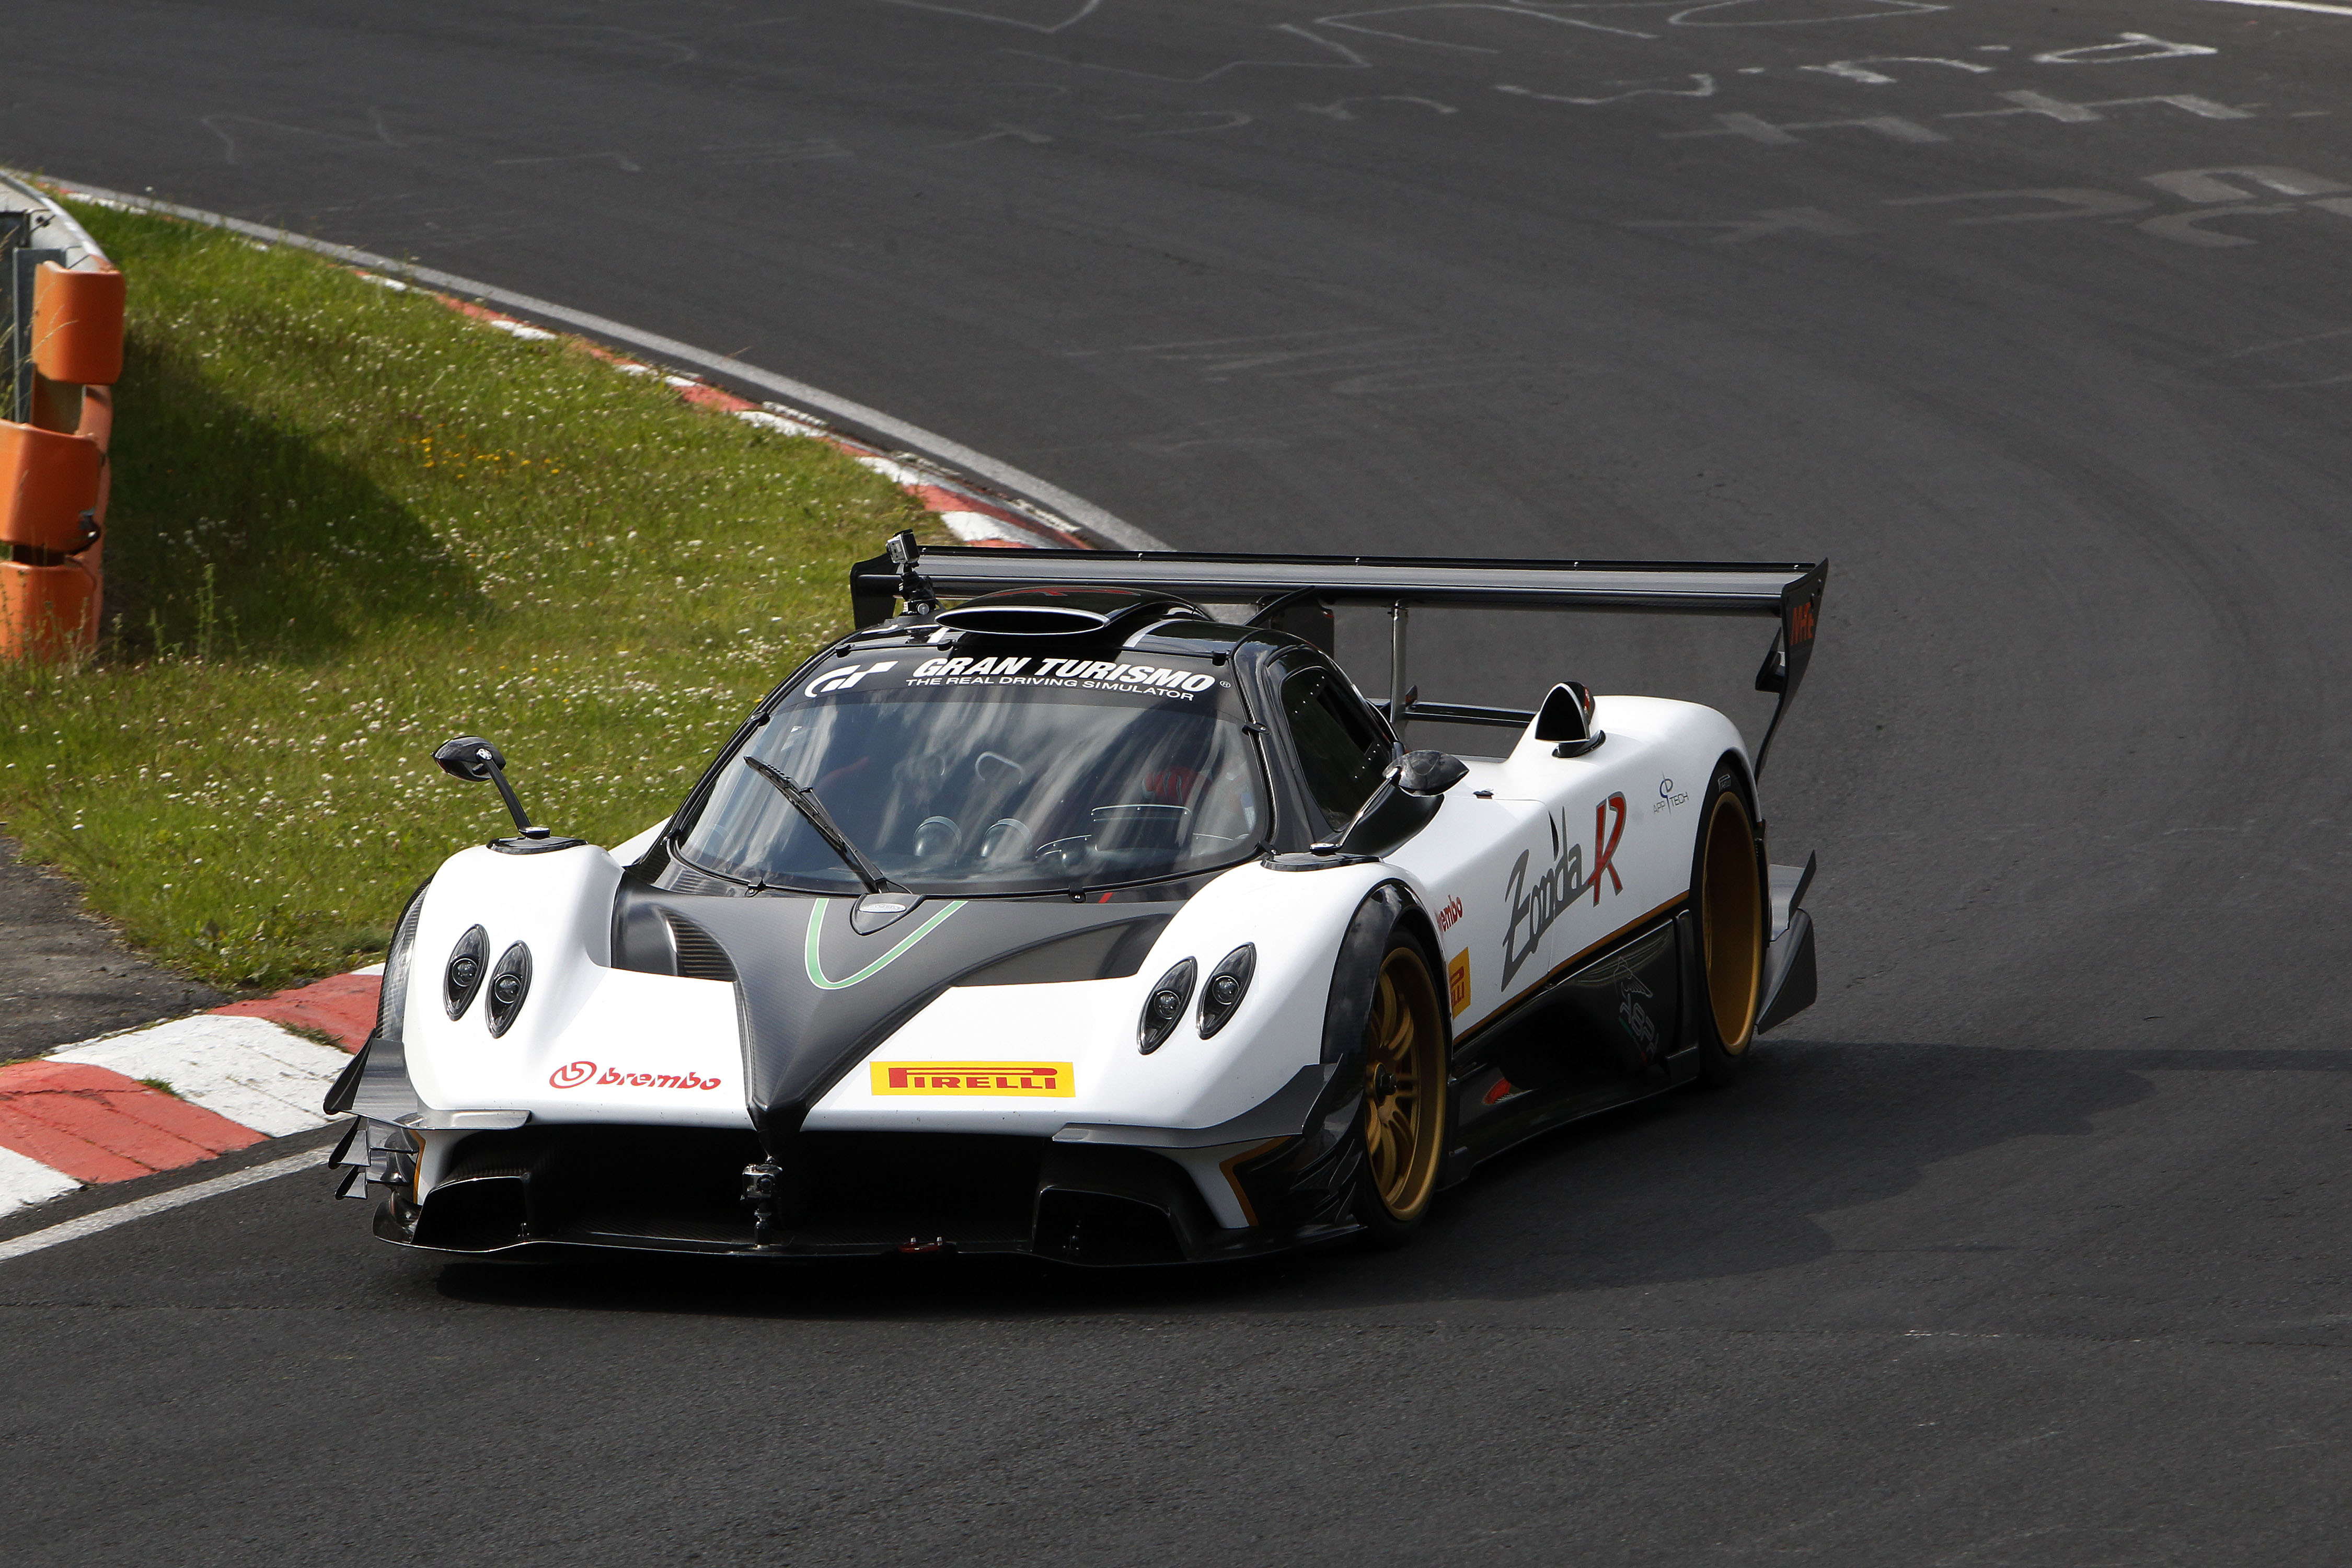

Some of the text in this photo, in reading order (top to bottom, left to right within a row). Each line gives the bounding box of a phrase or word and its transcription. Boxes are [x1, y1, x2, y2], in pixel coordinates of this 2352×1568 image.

[913, 657, 1030, 677] GRAN
[1034, 658, 1215, 692] TURISMO
[906, 678, 942, 686] THE
[998, 676, 1078, 687] DRIVING
[1082, 680, 1194, 701] SIMULATOR
[1501, 791, 1627, 993] Zonda R
[596, 1067, 721, 1090] brembo
[888, 1067, 1057, 1089] PIRELLI
